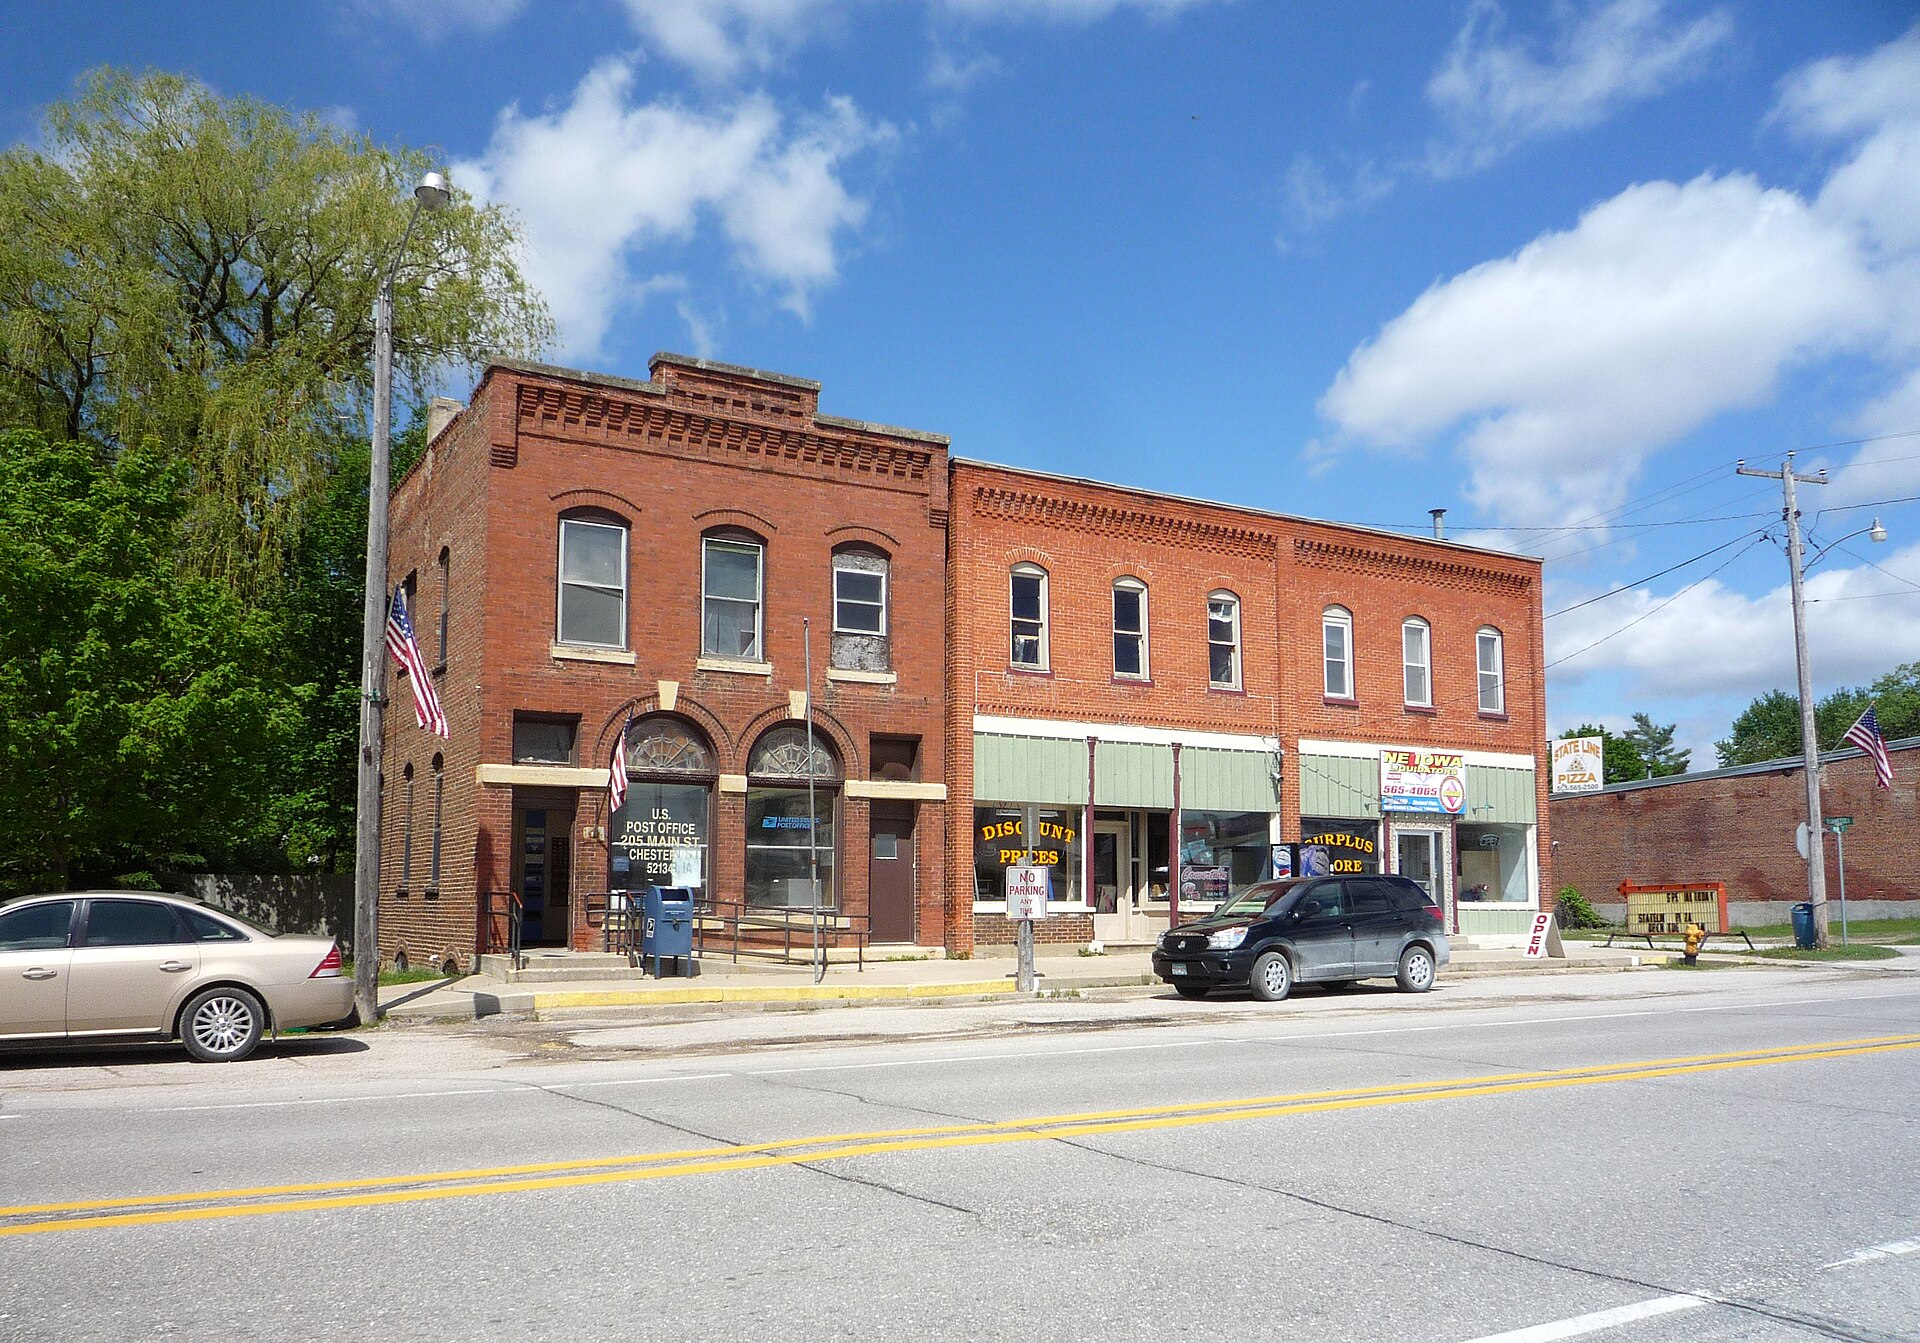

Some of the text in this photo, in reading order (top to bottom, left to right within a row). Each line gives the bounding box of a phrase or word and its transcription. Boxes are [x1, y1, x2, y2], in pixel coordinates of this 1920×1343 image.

[1554, 740, 1600, 763] STATE LINE
[1384, 752, 1463, 768] NE IOWA
[1389, 764, 1458, 775] LIQUIDATORS
[1558, 773, 1597, 784] PIZZA
[1383, 785, 1438, 796] 565-4065
[652, 808, 671, 820] U.S.
[626, 821, 696, 835] POST OFFICE
[982, 821, 1075, 843] DISCUNT
[620, 835, 700, 848] 205 MAIN ST
[647, 862, 673, 874] 52134
[1019, 872, 1035, 883] NO
[1009, 885, 1045, 896] PARKING
[1527, 915, 1548, 955] OPEN
